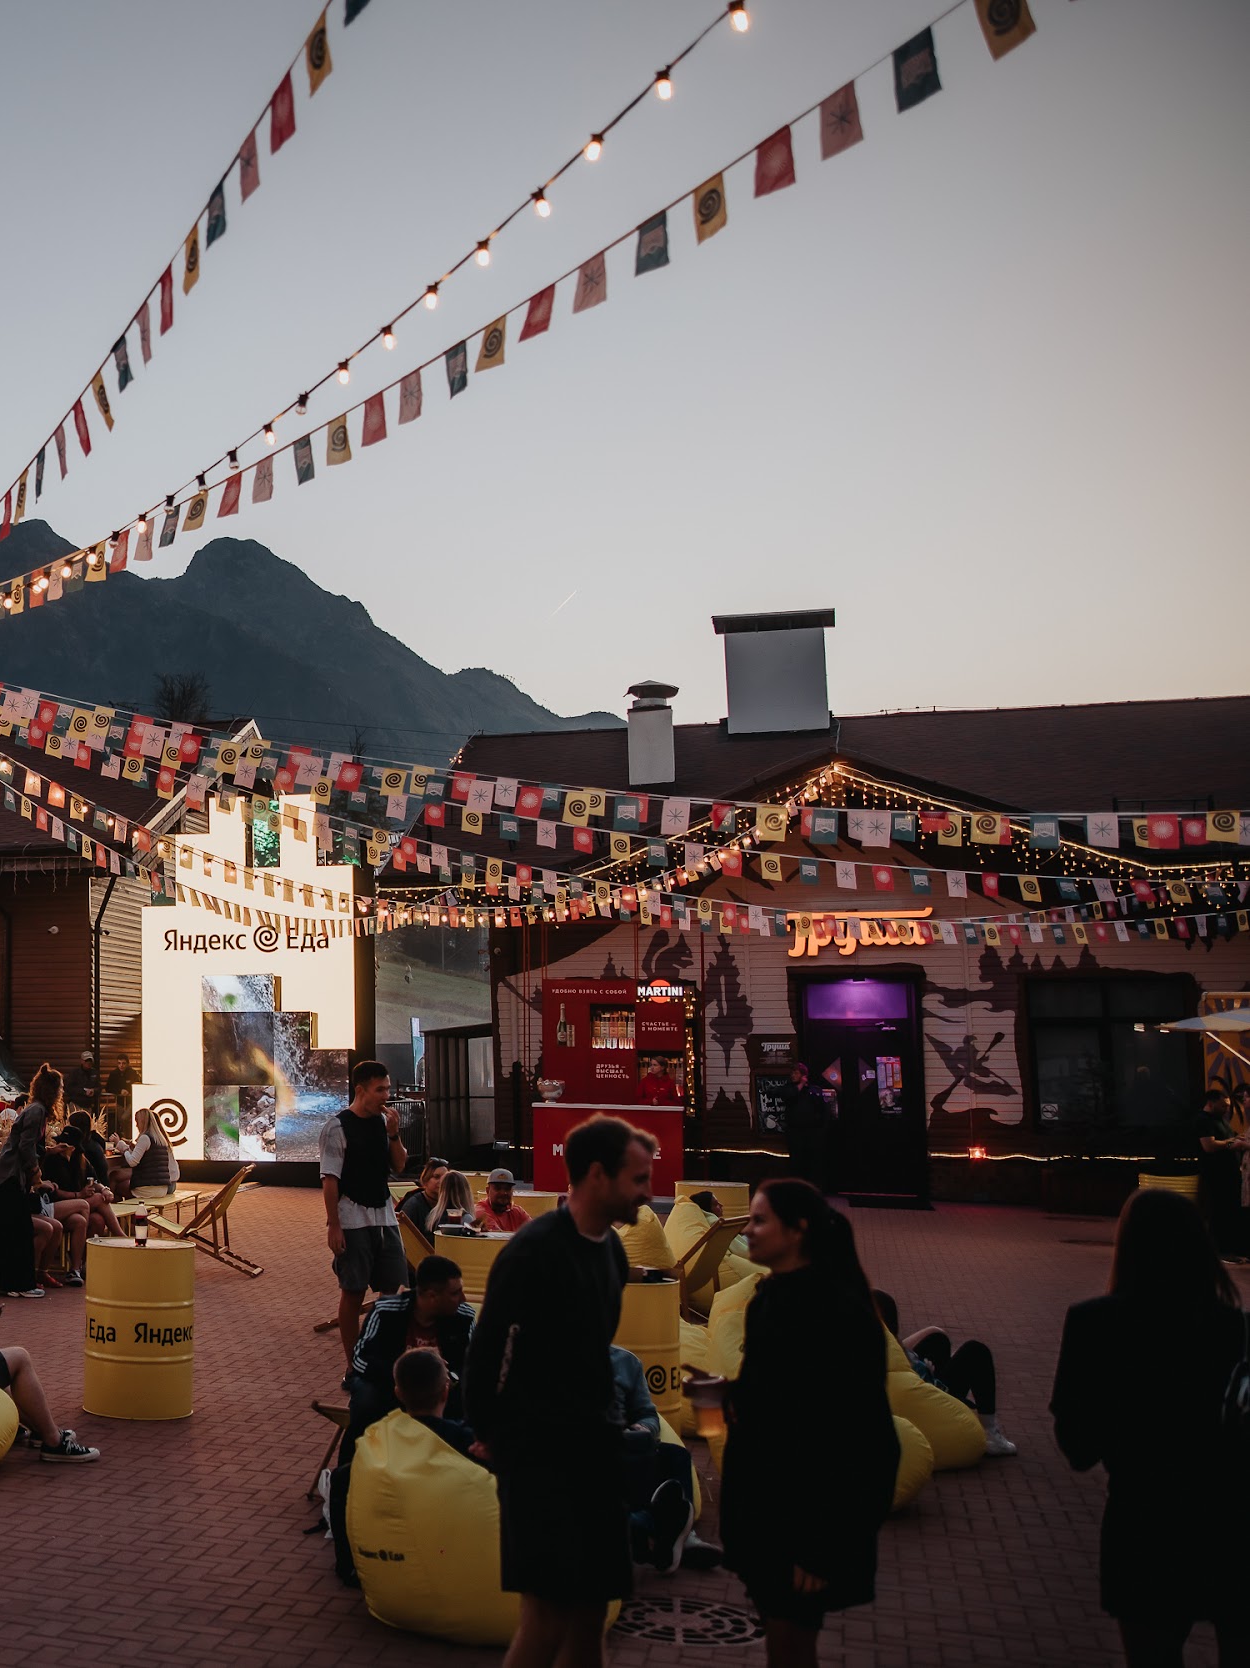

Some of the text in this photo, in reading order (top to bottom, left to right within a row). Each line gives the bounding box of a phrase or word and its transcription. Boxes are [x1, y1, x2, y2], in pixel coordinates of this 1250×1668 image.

[164, 926, 329, 954] Яндекс Еда
[637, 986, 684, 997] MARTINI
[89, 1317, 116, 1344] Еда
